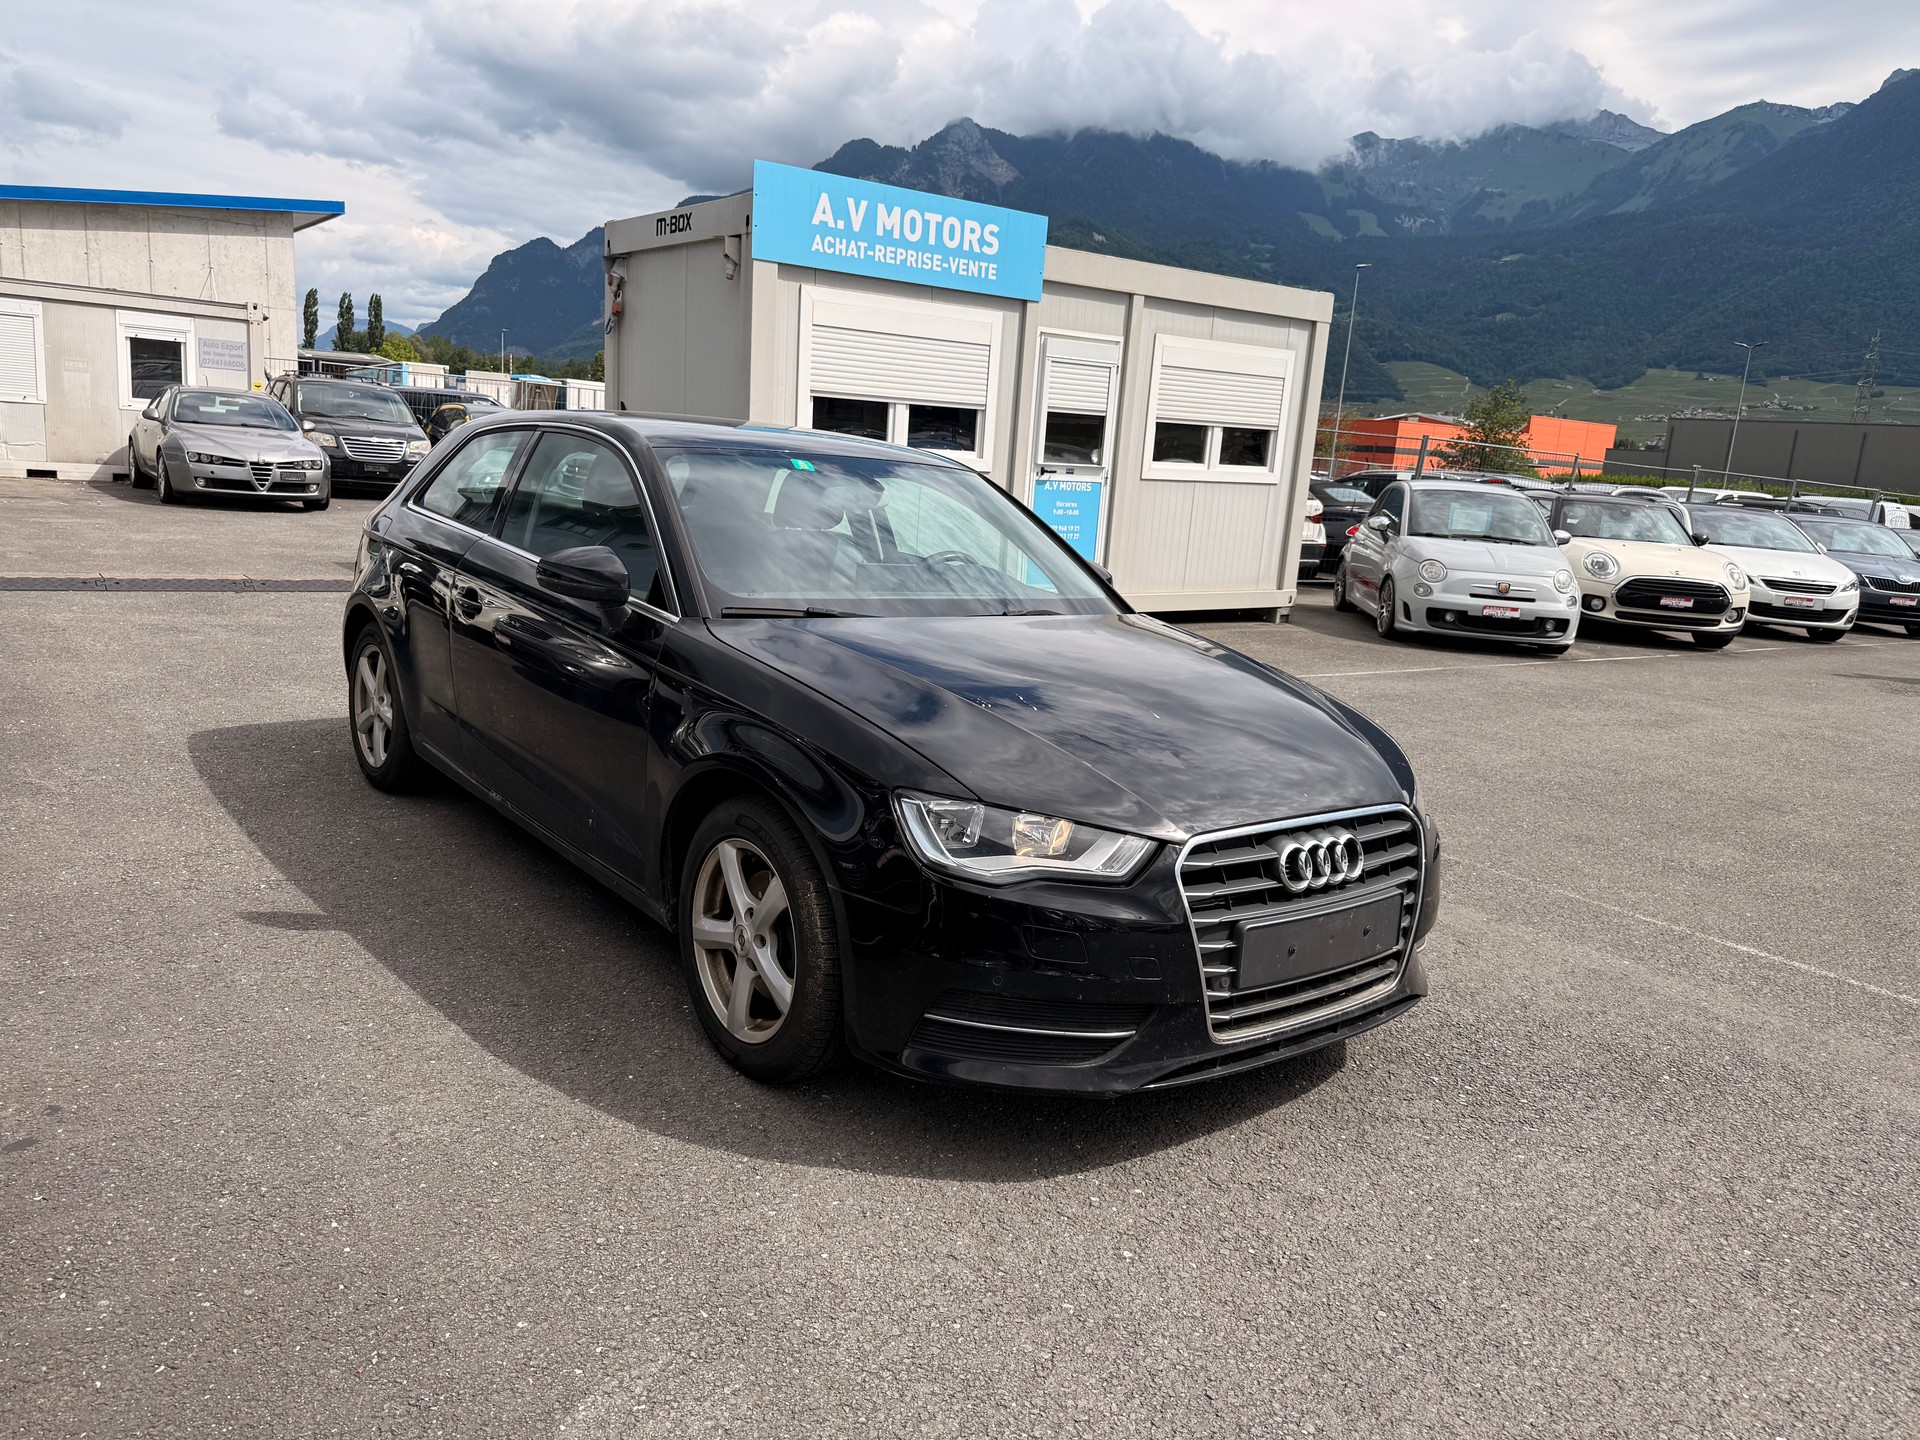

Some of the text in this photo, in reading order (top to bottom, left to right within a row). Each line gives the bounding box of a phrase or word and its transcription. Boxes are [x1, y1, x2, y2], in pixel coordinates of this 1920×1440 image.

[811, 192, 1000, 256] A.V MOTORS
[811, 234, 998, 281] ACHAT-REPRISE-VENTE
[202, 341, 243, 352] Auto Export
[1044, 481, 1092, 491] A.V MOTORS
